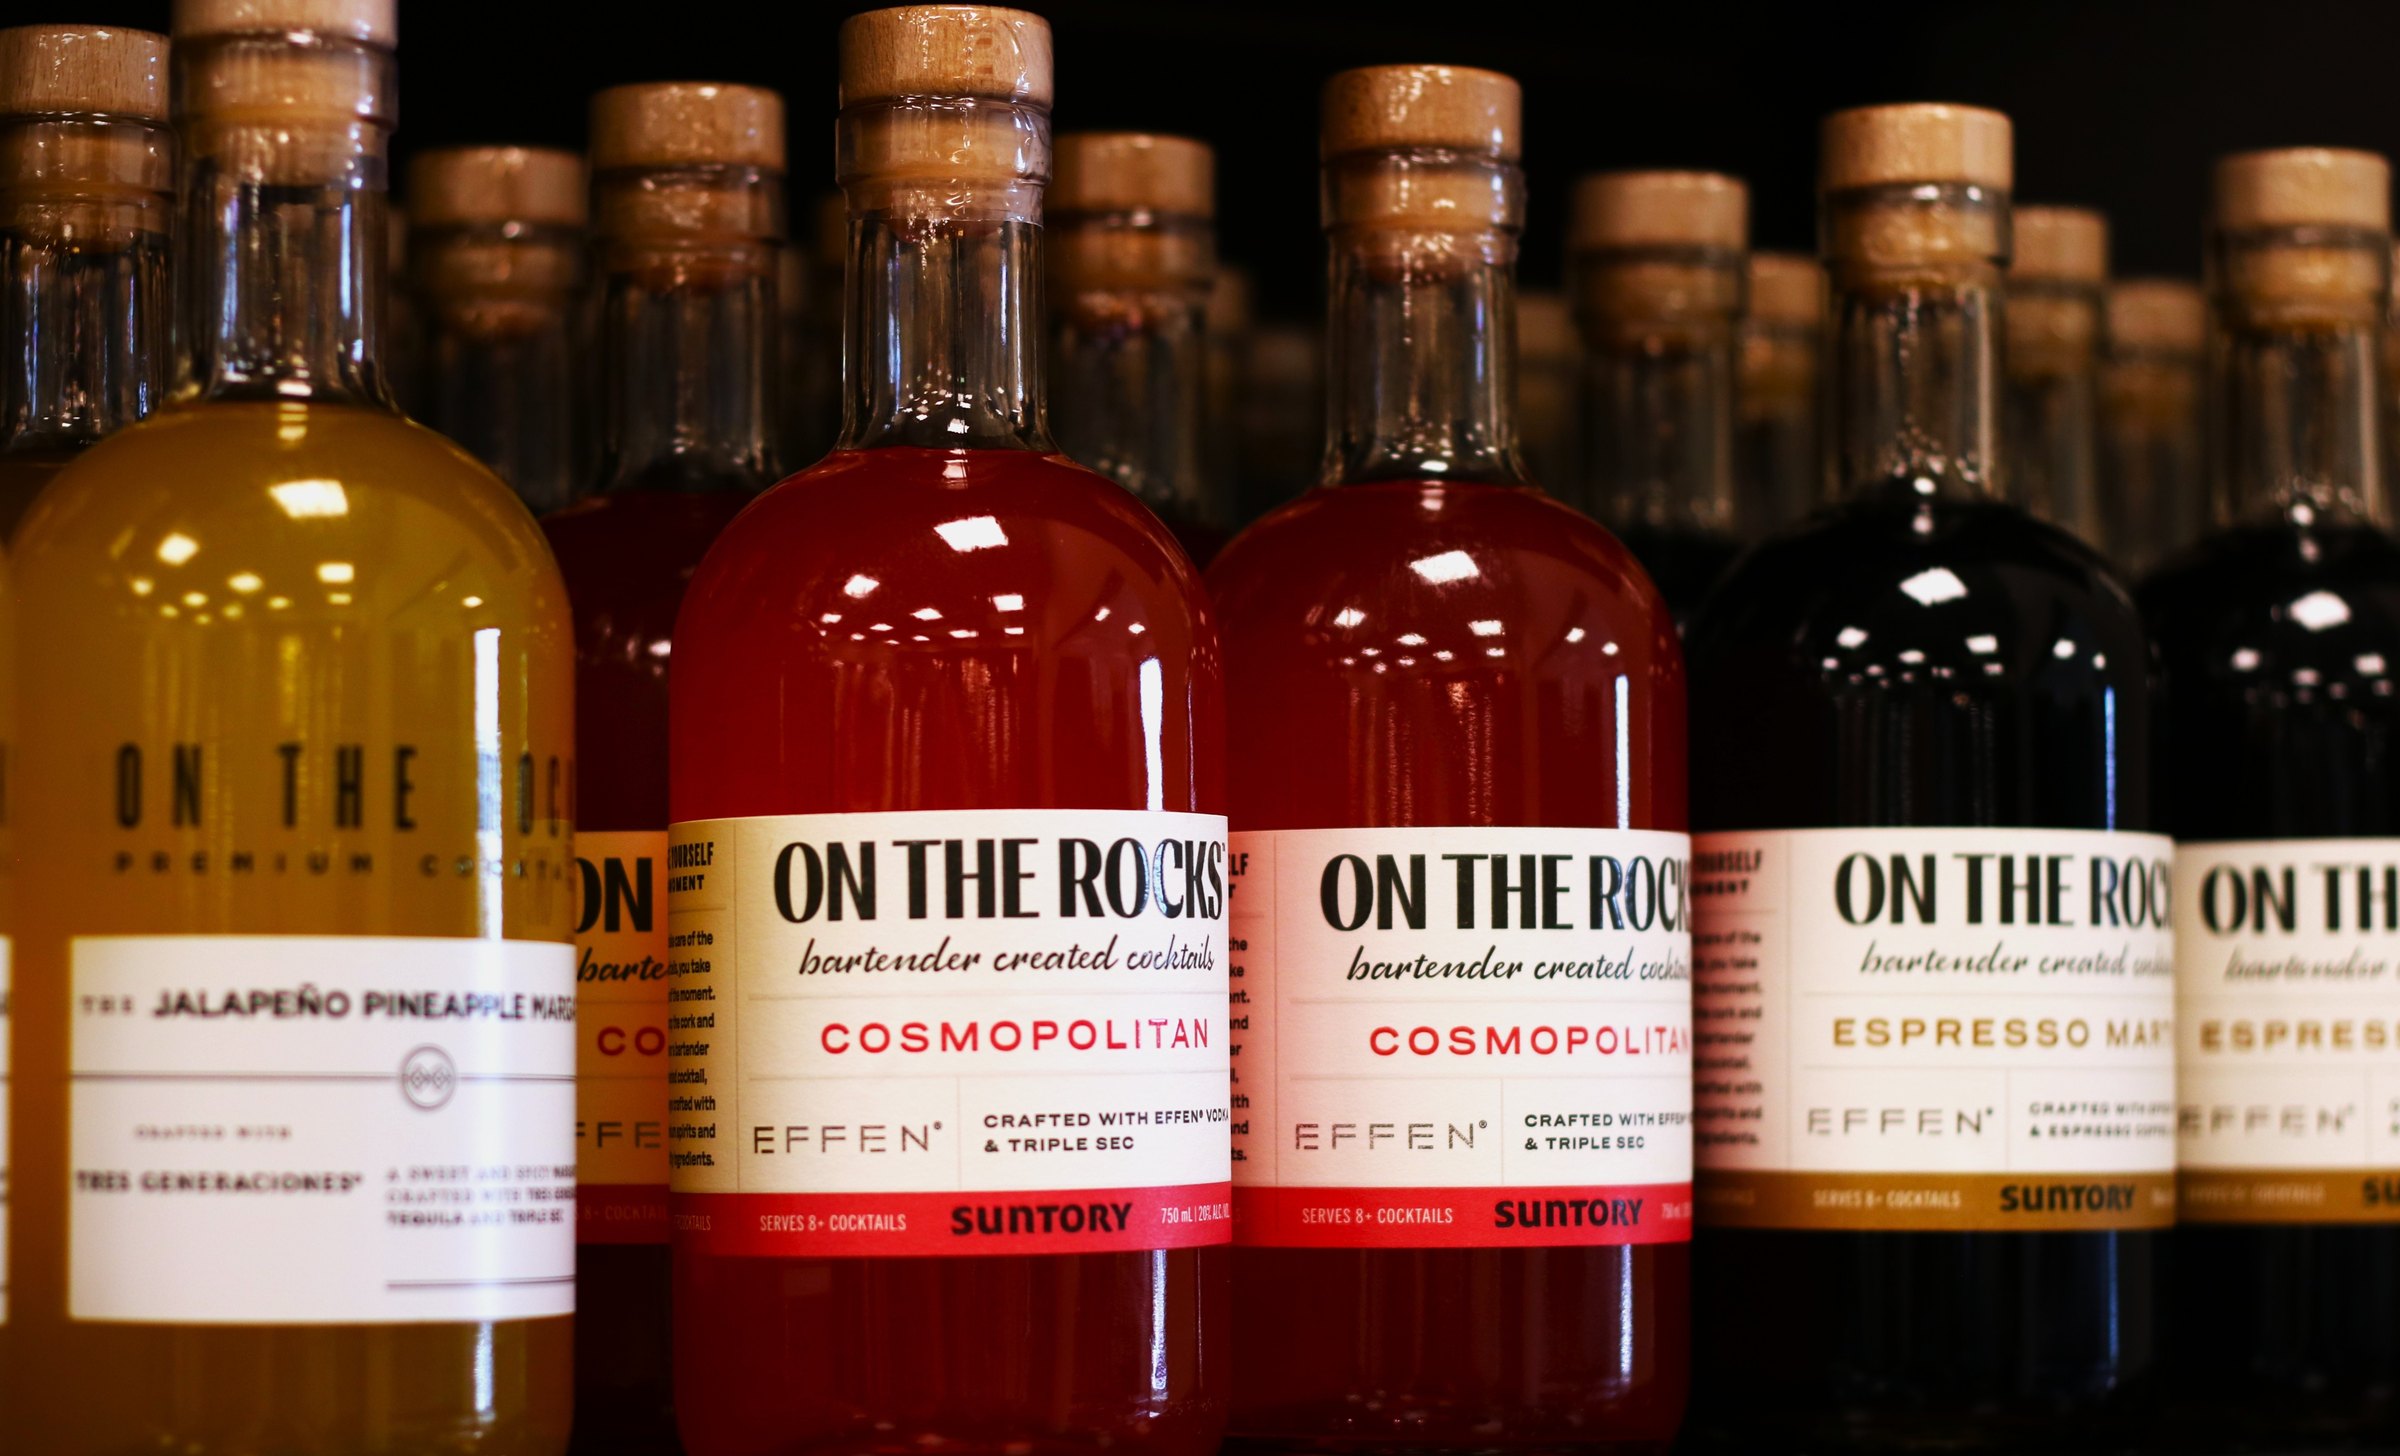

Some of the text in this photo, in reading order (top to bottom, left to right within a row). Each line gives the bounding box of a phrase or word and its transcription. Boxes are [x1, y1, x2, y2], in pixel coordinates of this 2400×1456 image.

[117, 743, 203, 829] ON
[277, 743, 417, 829] THE
[115, 854, 373, 874] PREMIUM
[773, 840, 875, 924] ON
[892, 839, 1039, 921] THE
[1834, 852, 1937, 928] ON
[1953, 853, 2074, 927] THE
[1319, 853, 1427, 931] ON
[1441, 853, 1574, 931] THE
[2199, 864, 2295, 936] ON
[697, 930, 714, 945] the
[799, 931, 1216, 977] bartender created cocktails
[1347, 945, 1523, 981] bartender
[1534, 945, 1634, 980] created
[1860, 940, 2030, 976] bartender
[2038, 943, 2130, 975] created
[691, 958, 711, 974] take
[153, 983, 352, 1020] JALAPEÑO
[364, 991, 526, 1020] PINEAPPLE
[697, 1012, 715, 1027] and
[820, 1017, 1210, 1055] COSMOPOLITAN
[1832, 1018, 2090, 1047] ESPRESSO
[694, 1095, 716, 1110] with
[984, 1113, 1091, 1129] CRAFTED
[1098, 1111, 1149, 1126] WITH
[1524, 1113, 1613, 1127] CRAFTED
[1619, 1112, 1655, 1126] WITH
[697, 1123, 716, 1138] and
[984, 1136, 1135, 1153] & TRIPLE SEC
[1524, 1135, 1645, 1150] & TRIPLE SEC
[759, 1213, 907, 1232] SERVES 8+ COCKTAILS
[1160, 1206, 1179, 1224] 750
[1180, 1205, 1193, 1222] mL
[1301, 1206, 1453, 1224] SERVES 8+ COCKTAILS
